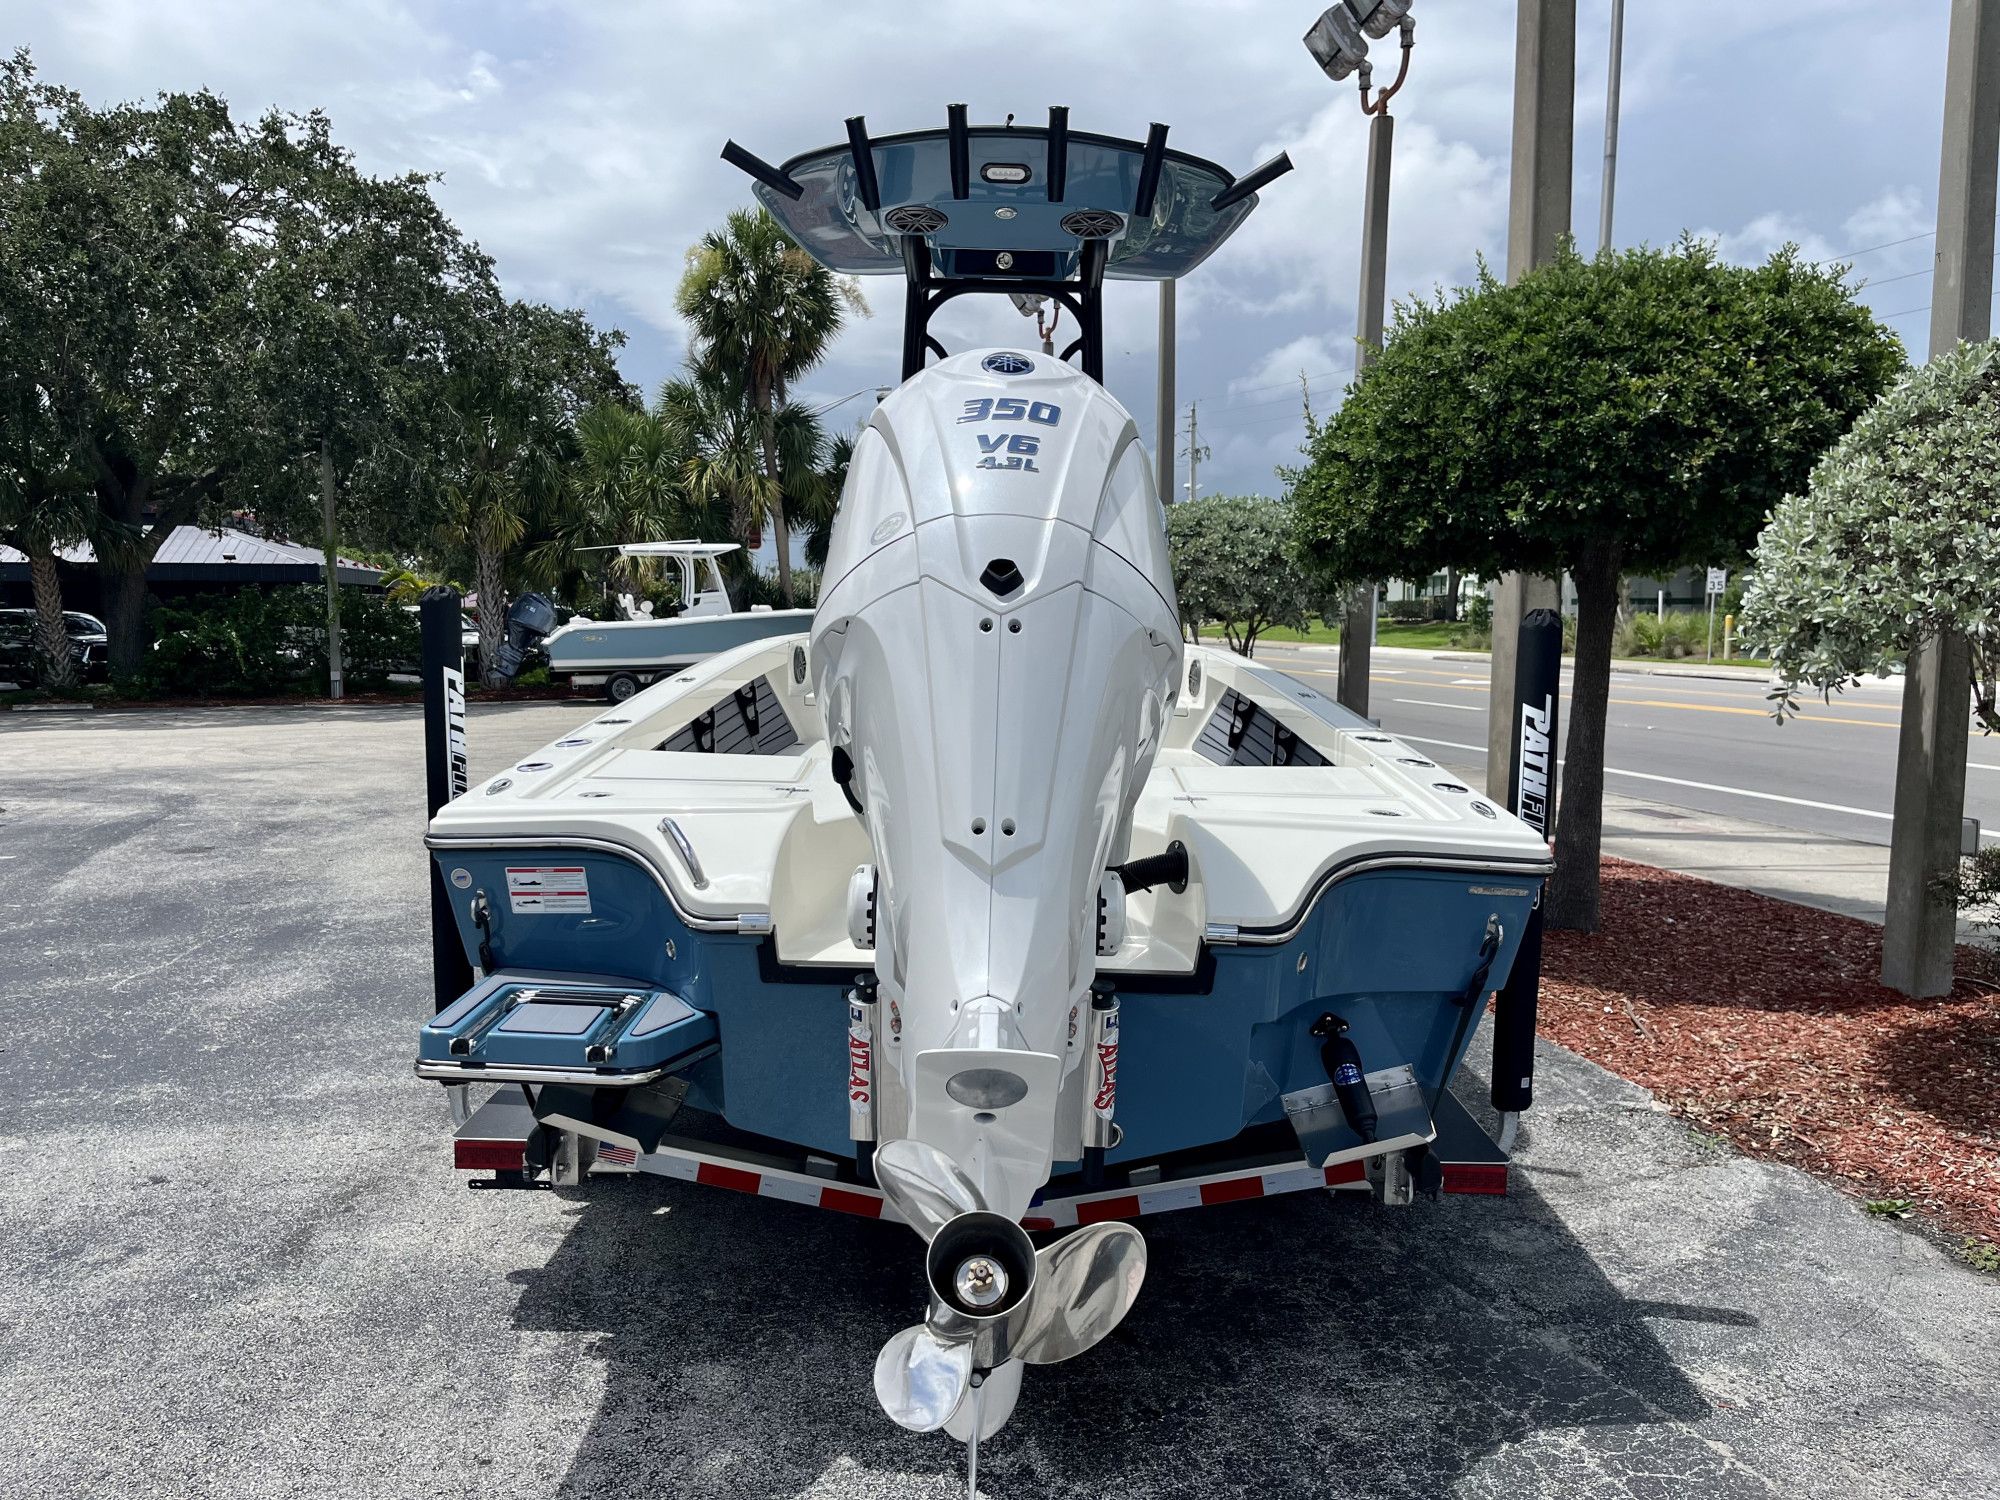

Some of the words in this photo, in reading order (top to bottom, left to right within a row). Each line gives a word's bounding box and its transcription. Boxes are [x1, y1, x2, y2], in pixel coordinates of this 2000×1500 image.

[956, 398, 1062, 427] 350
[977, 433, 1041, 456] V6
[1708, 580, 1724, 590] 35
[849, 1033, 870, 1104] ATLAS
[1094, 1041, 1118, 1110] ATLAS
